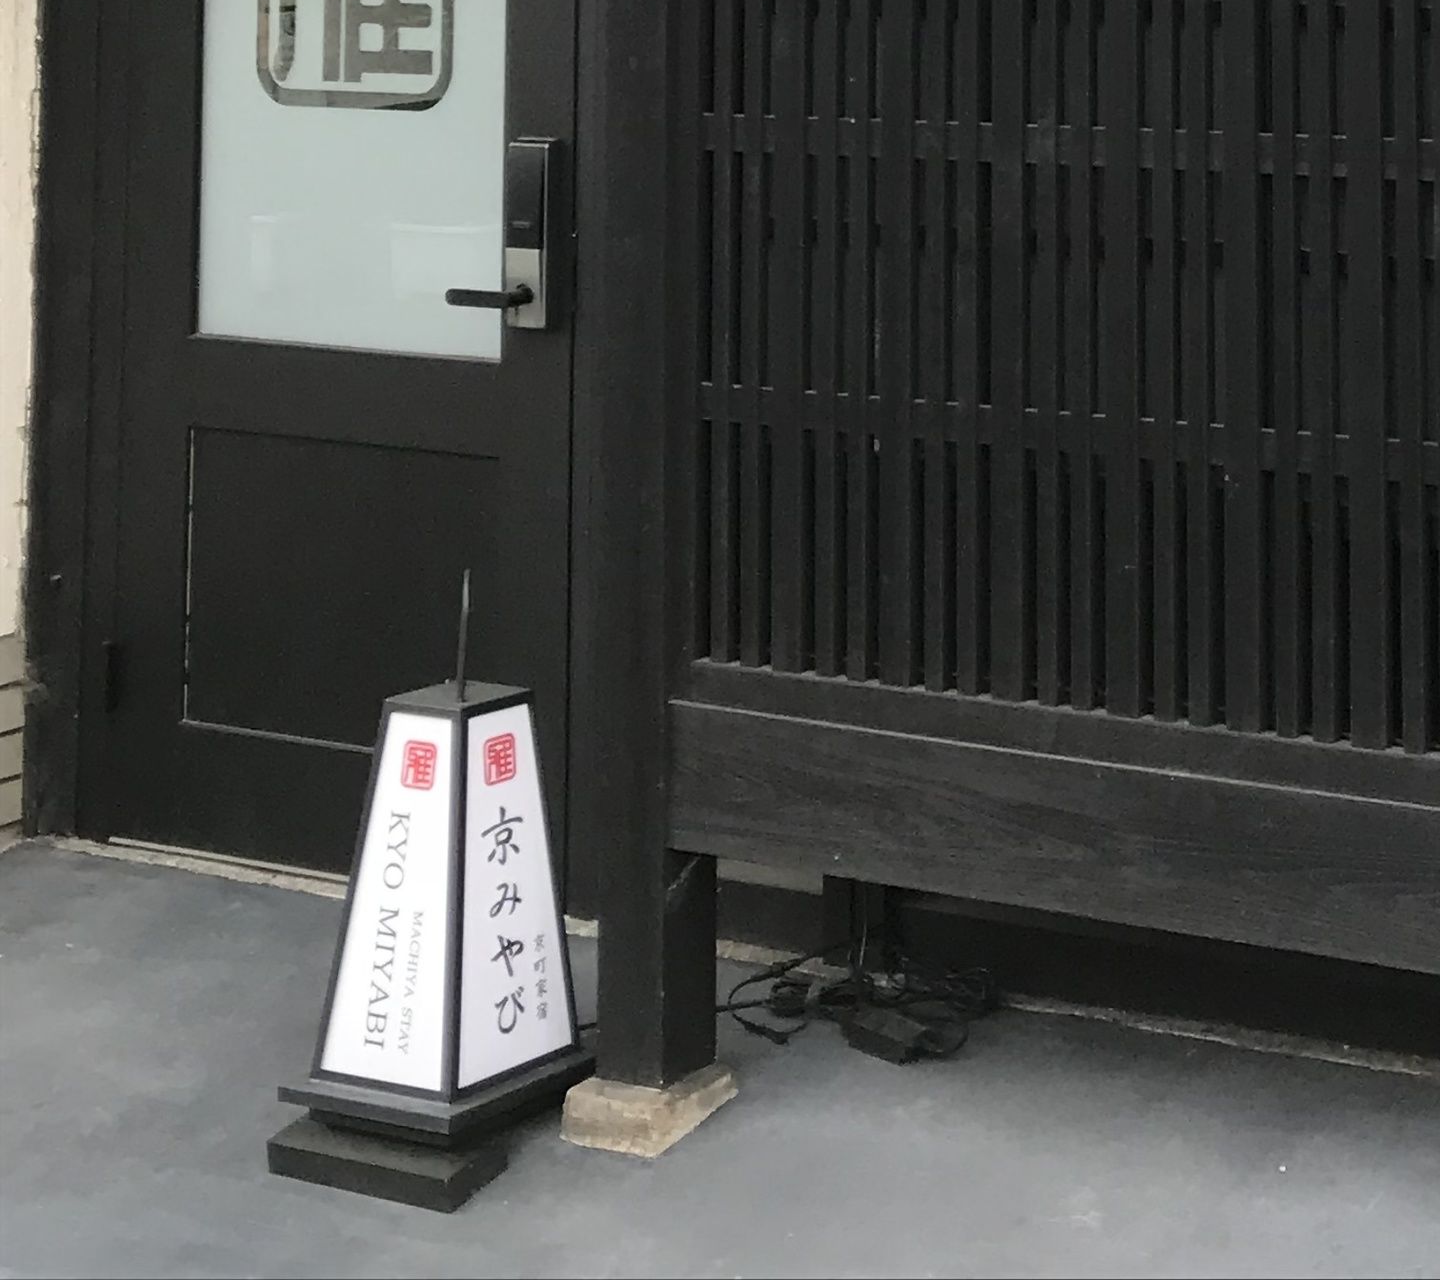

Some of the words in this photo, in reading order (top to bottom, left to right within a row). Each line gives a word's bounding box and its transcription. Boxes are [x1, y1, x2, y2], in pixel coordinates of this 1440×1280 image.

[383, 811, 411, 890] KYO
[403, 911, 424, 998] MACHIYA
[481, 806, 525, 1034] 京みやび
[364, 906, 400, 1049] MIYABI
[398, 1006, 413, 1056] STAY
